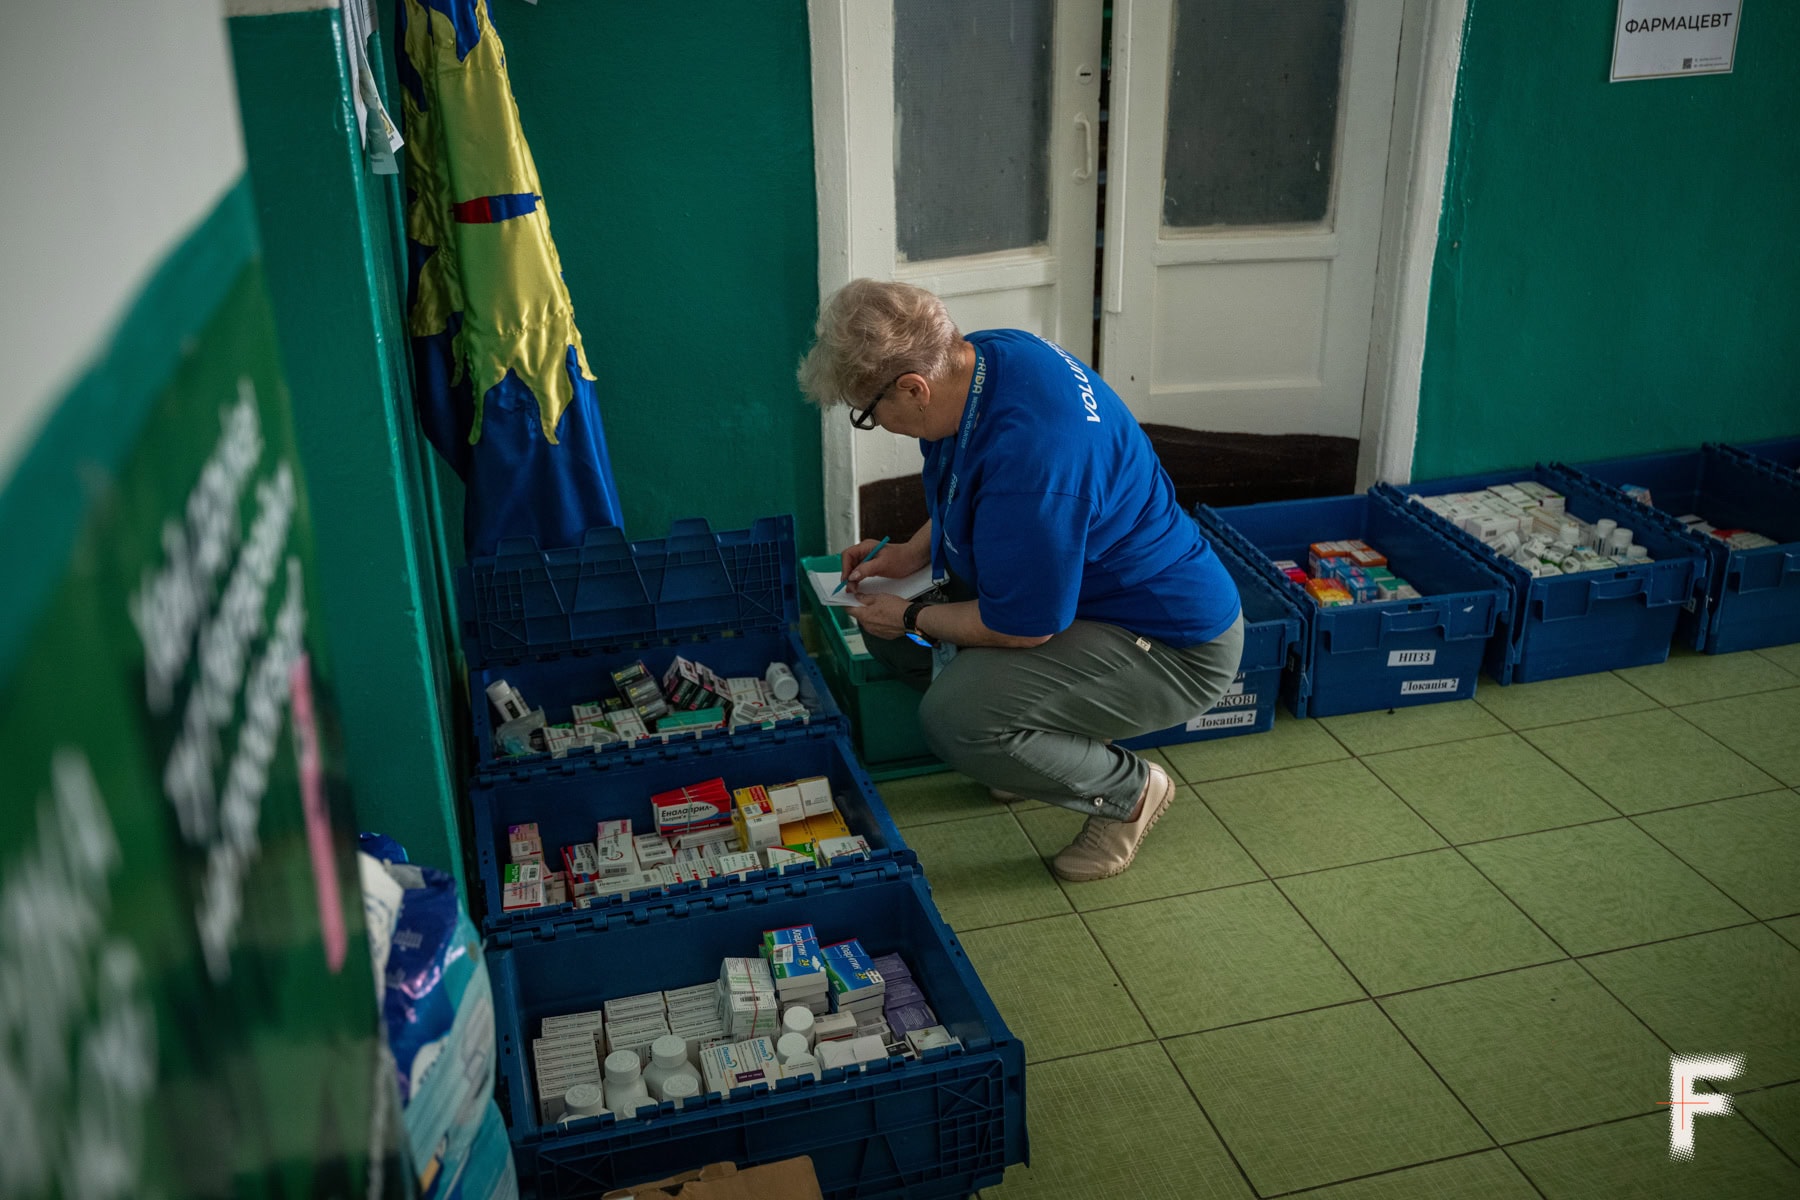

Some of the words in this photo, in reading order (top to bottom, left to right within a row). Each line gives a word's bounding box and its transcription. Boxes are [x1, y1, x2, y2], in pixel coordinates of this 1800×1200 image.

[1625, 13, 1732, 33] ФАРМАЦЕВТ
[1402, 679, 1447, 691] Локація
[1450, 679, 1456, 688] 2
[1196, 714, 1243, 728] Локація
[1247, 713, 1253, 722] 2
